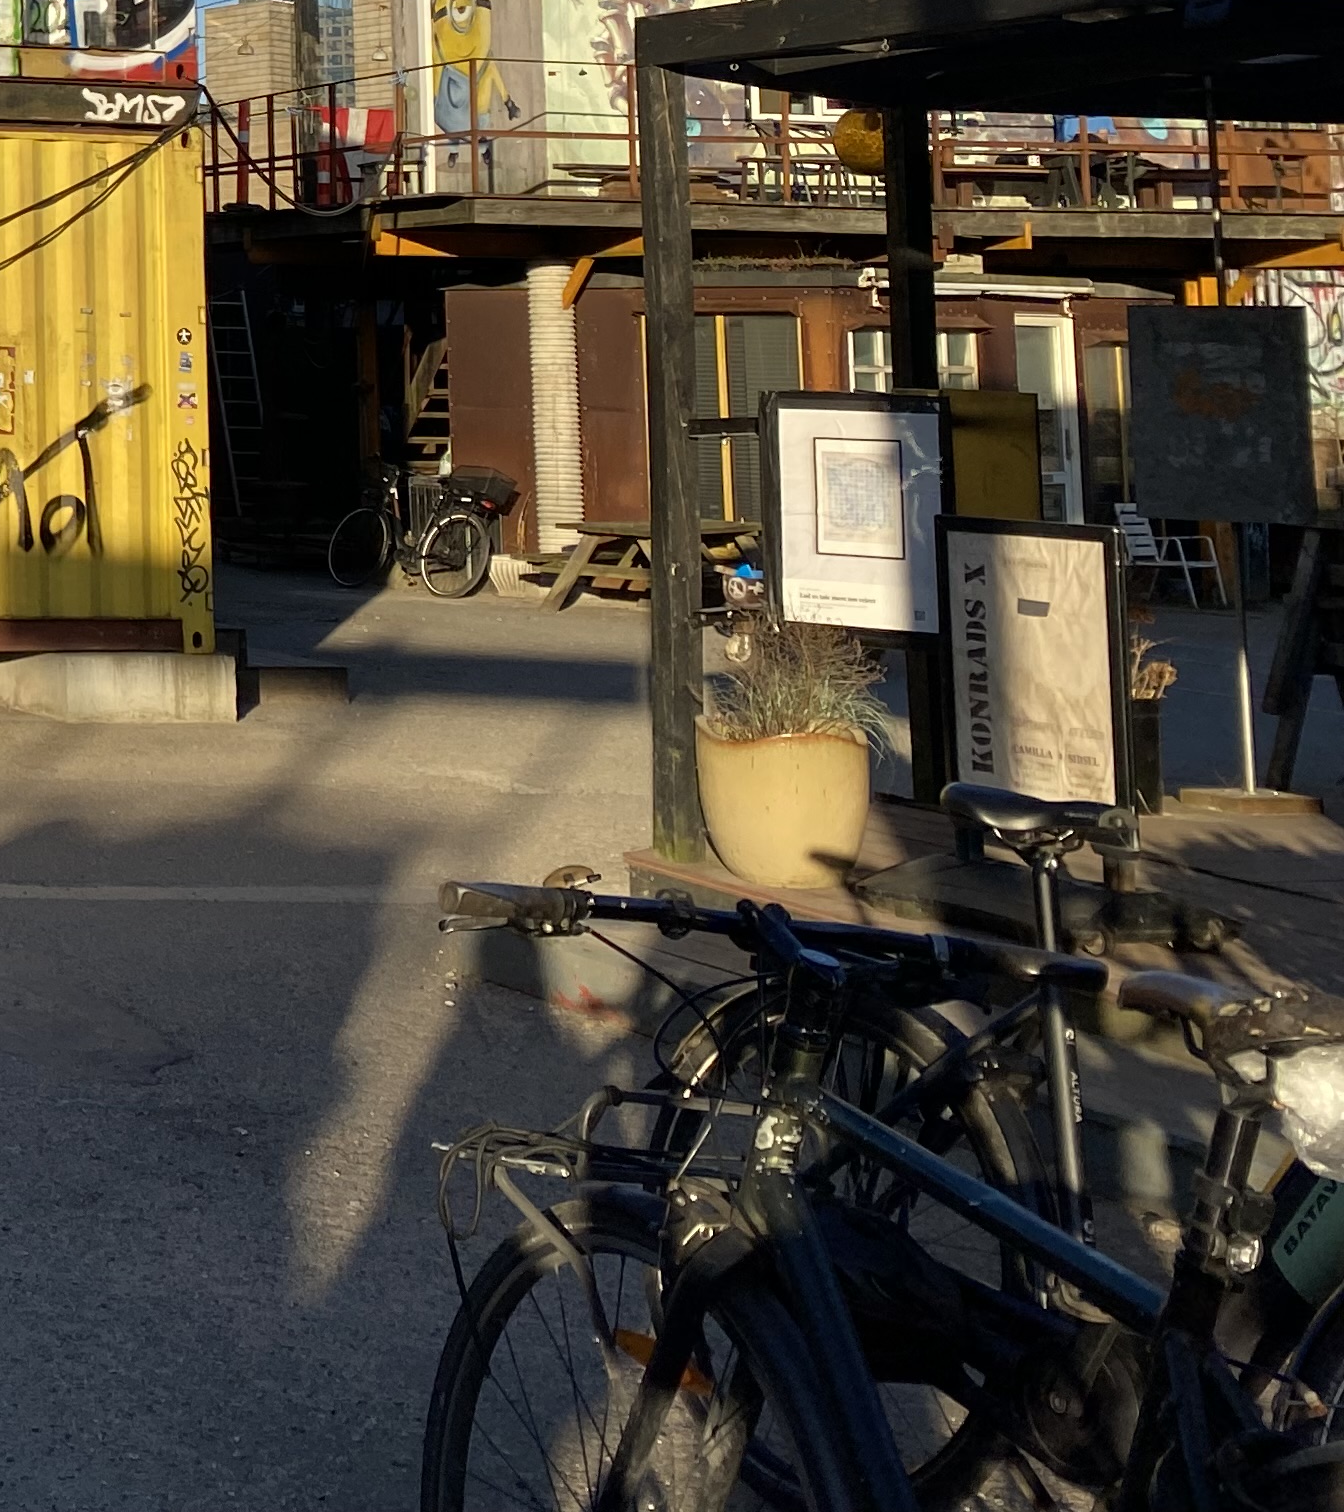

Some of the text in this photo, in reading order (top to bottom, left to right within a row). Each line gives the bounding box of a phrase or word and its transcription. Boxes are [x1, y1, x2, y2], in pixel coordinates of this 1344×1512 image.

[964, 563, 995, 774] KONRADS X
[1012, 743, 1053, 760] CAMILLA
[1070, 1071, 1083, 1124] ALTURA
